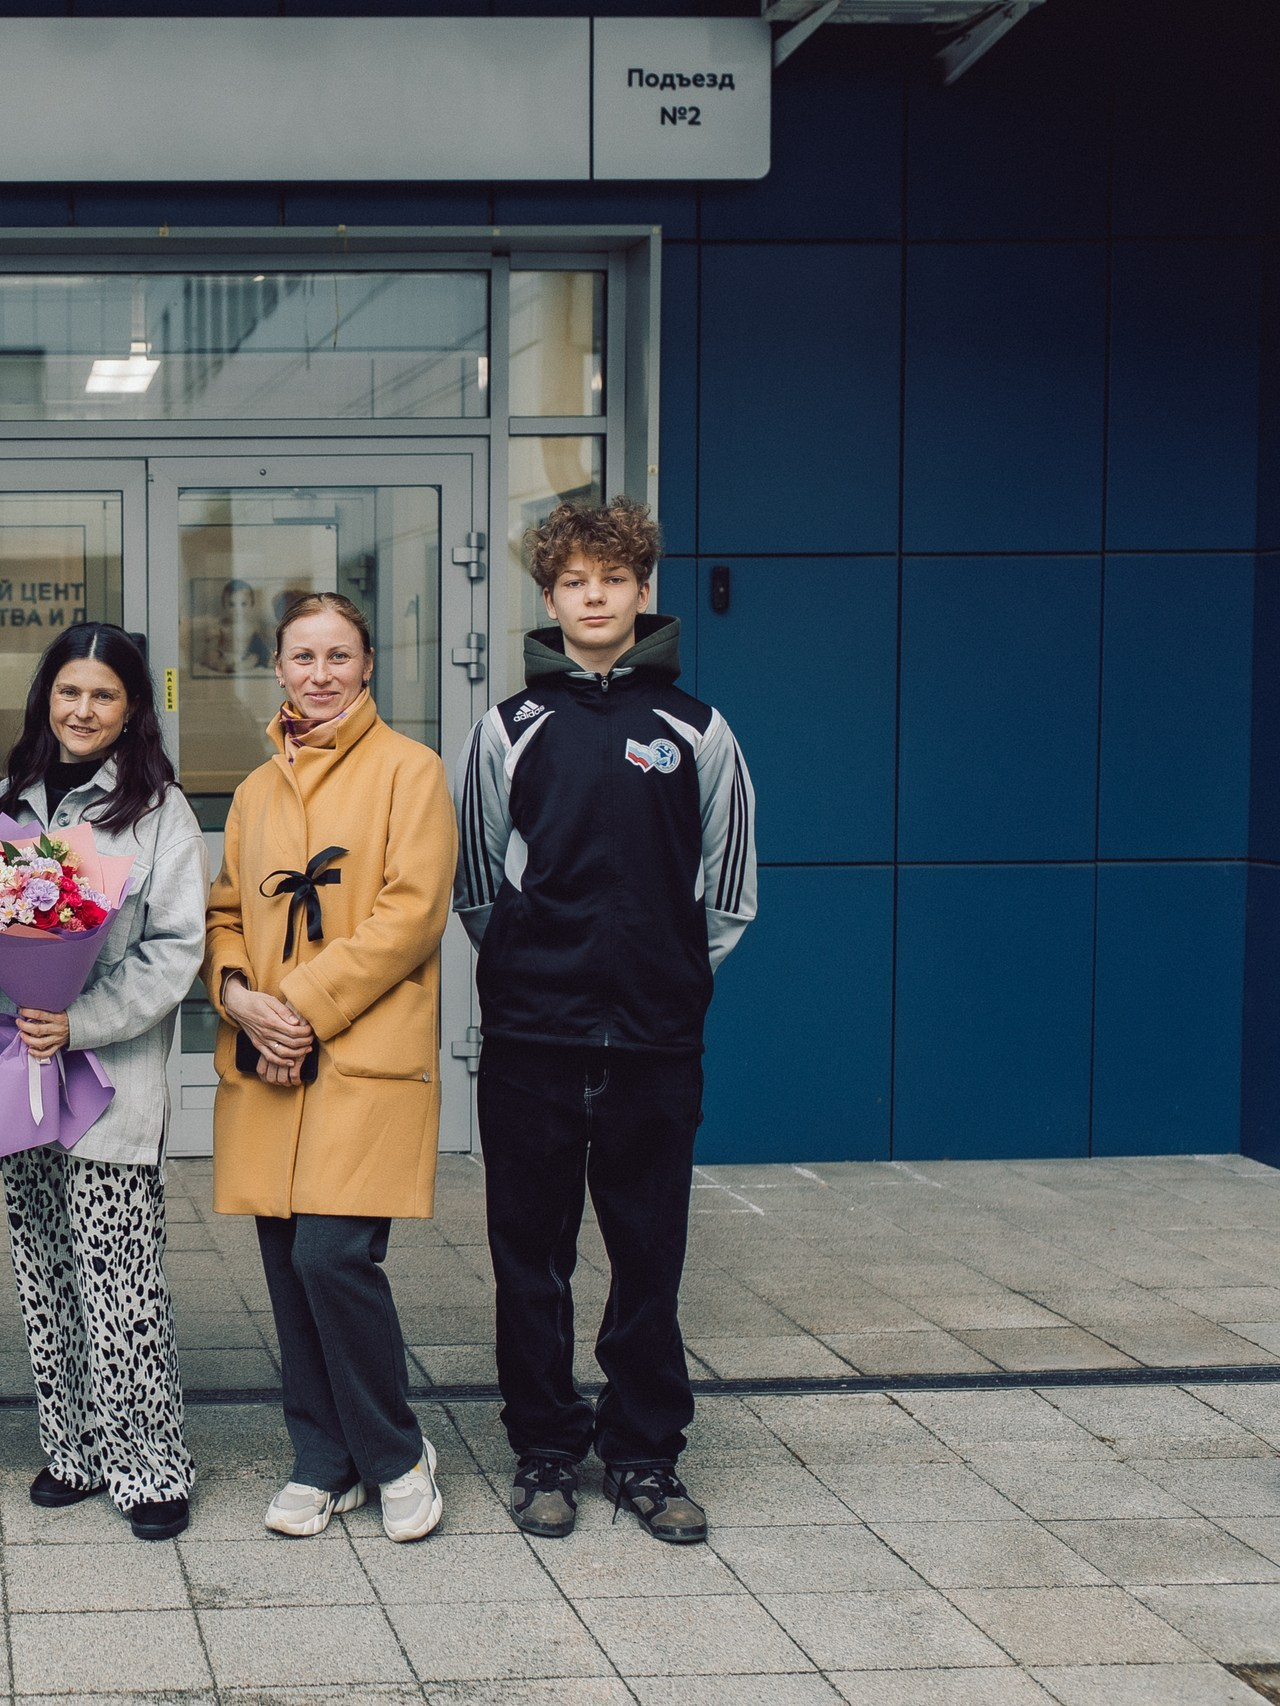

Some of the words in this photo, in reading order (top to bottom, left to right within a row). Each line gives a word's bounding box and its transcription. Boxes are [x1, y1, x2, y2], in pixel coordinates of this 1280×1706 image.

[627, 68, 735, 91] Подъезд
[660, 106, 701, 126] №2
[48, 607, 64, 627] И
[513, 704, 545, 722] adidas
